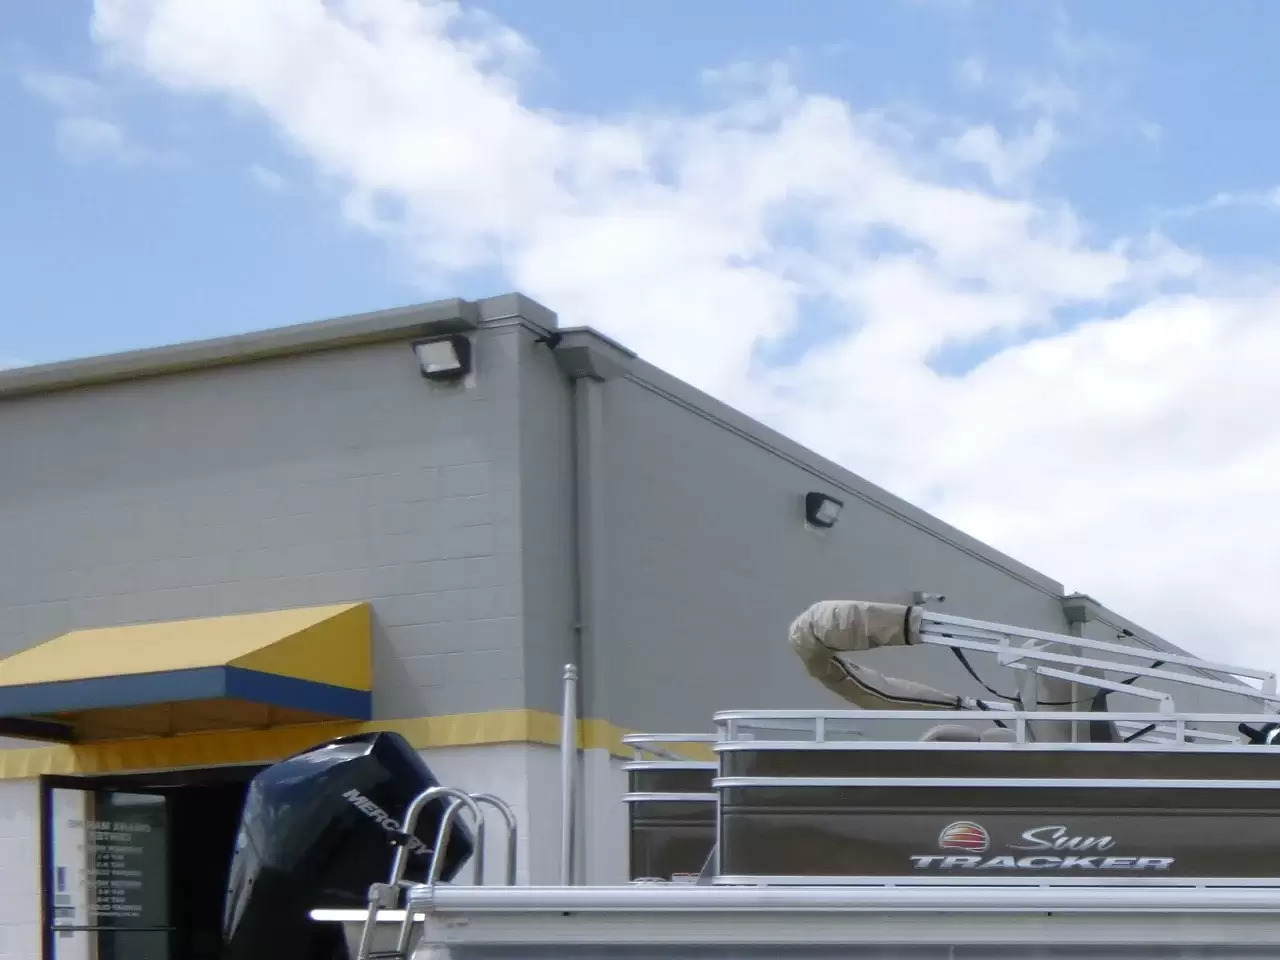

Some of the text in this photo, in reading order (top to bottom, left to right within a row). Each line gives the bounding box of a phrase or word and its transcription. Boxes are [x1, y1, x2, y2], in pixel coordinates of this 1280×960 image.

[341, 788, 435, 855] MERCRY
[1005, 825, 1116, 851] Sun
[909, 855, 1177, 871] TRACKER
